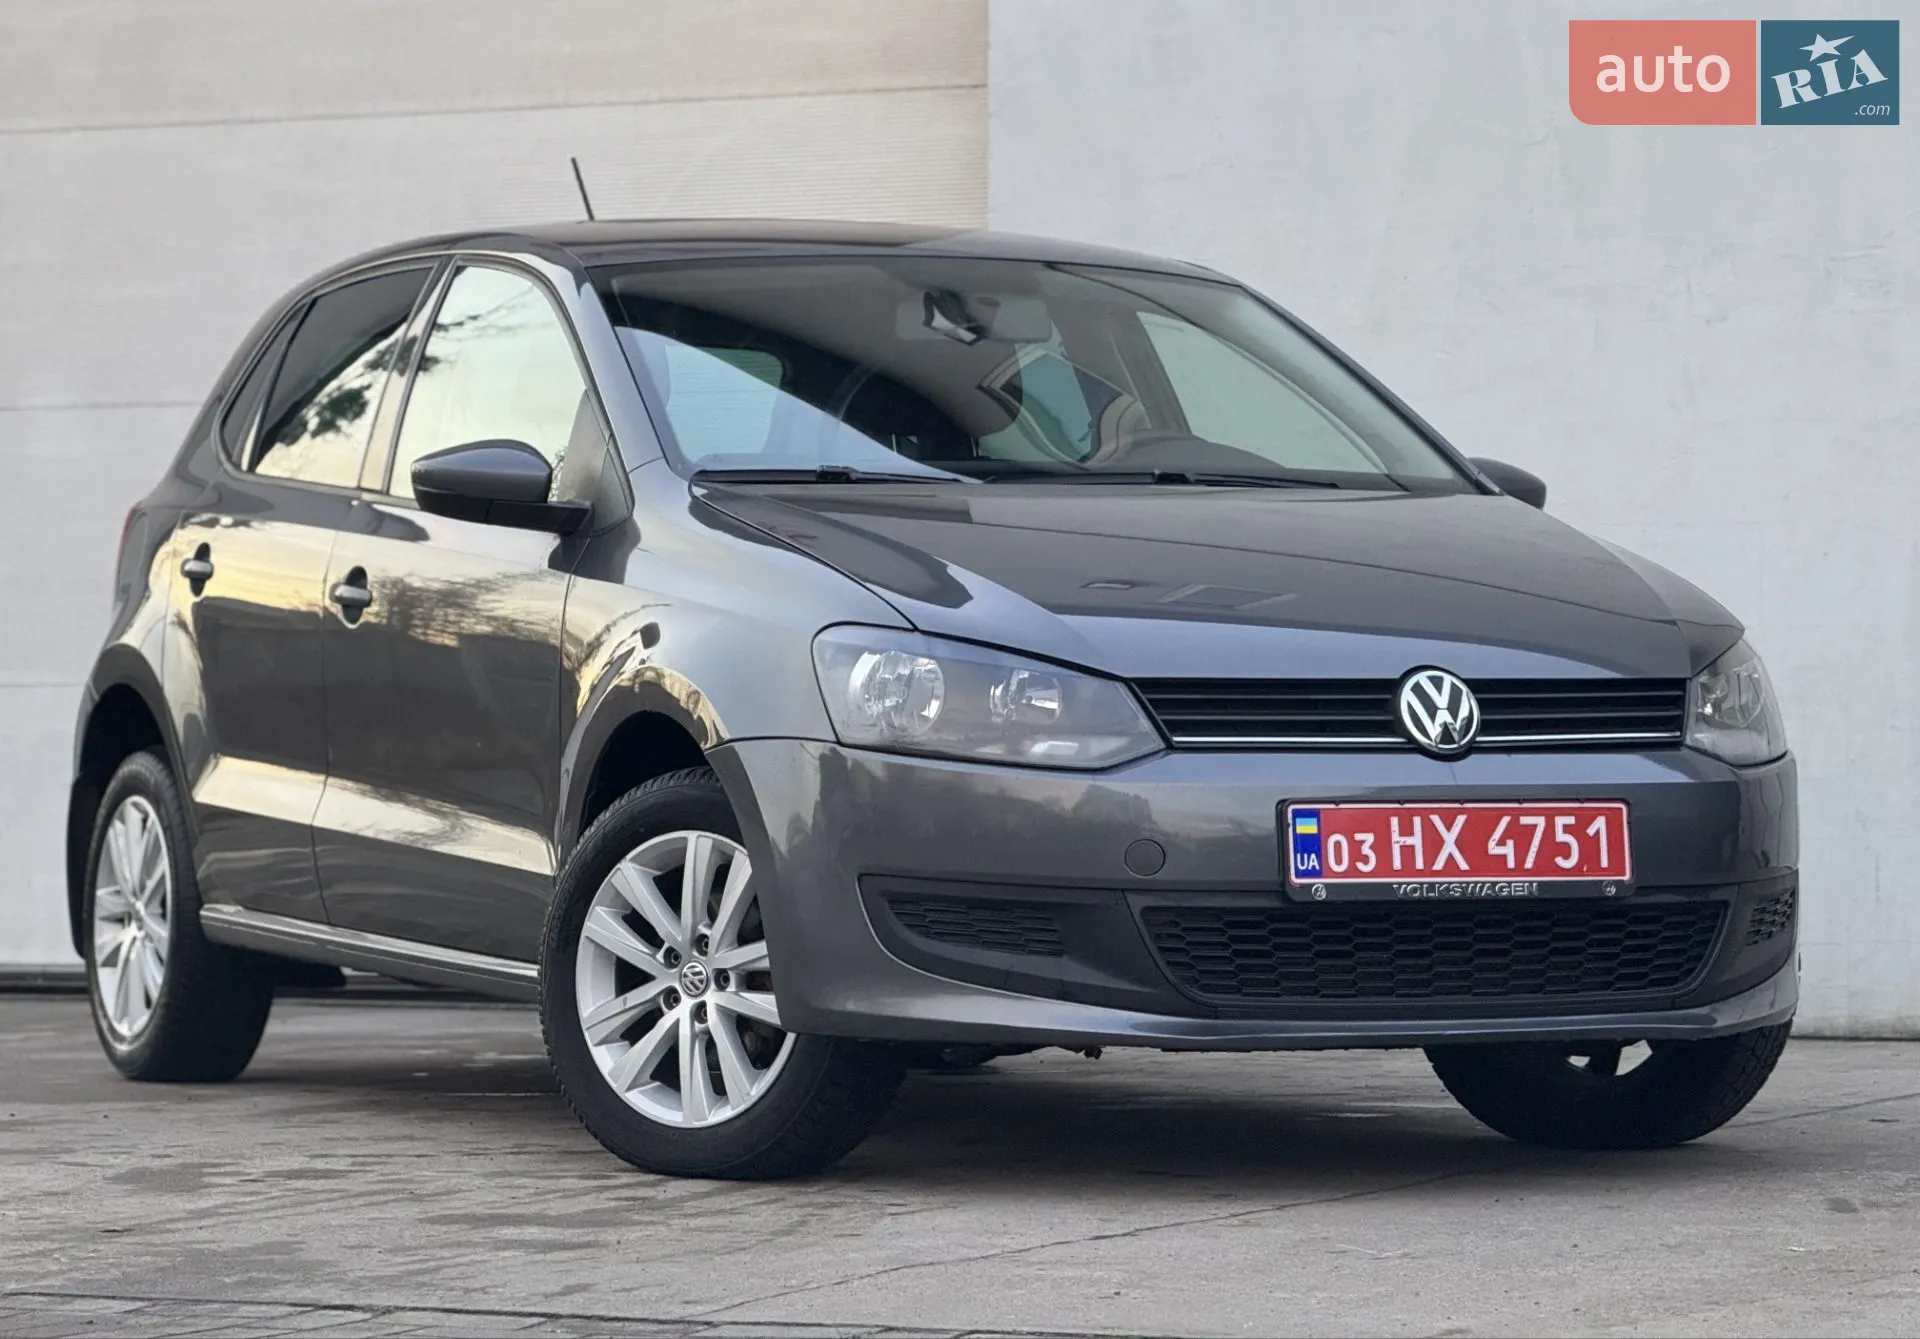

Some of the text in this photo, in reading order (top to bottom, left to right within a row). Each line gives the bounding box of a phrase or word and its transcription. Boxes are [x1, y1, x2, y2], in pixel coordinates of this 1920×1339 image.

[1326, 814, 1609, 873] 03 HX 4751
[1296, 853, 1320, 871] UA
[1393, 882, 1539, 898] VOLKSWAGEN
